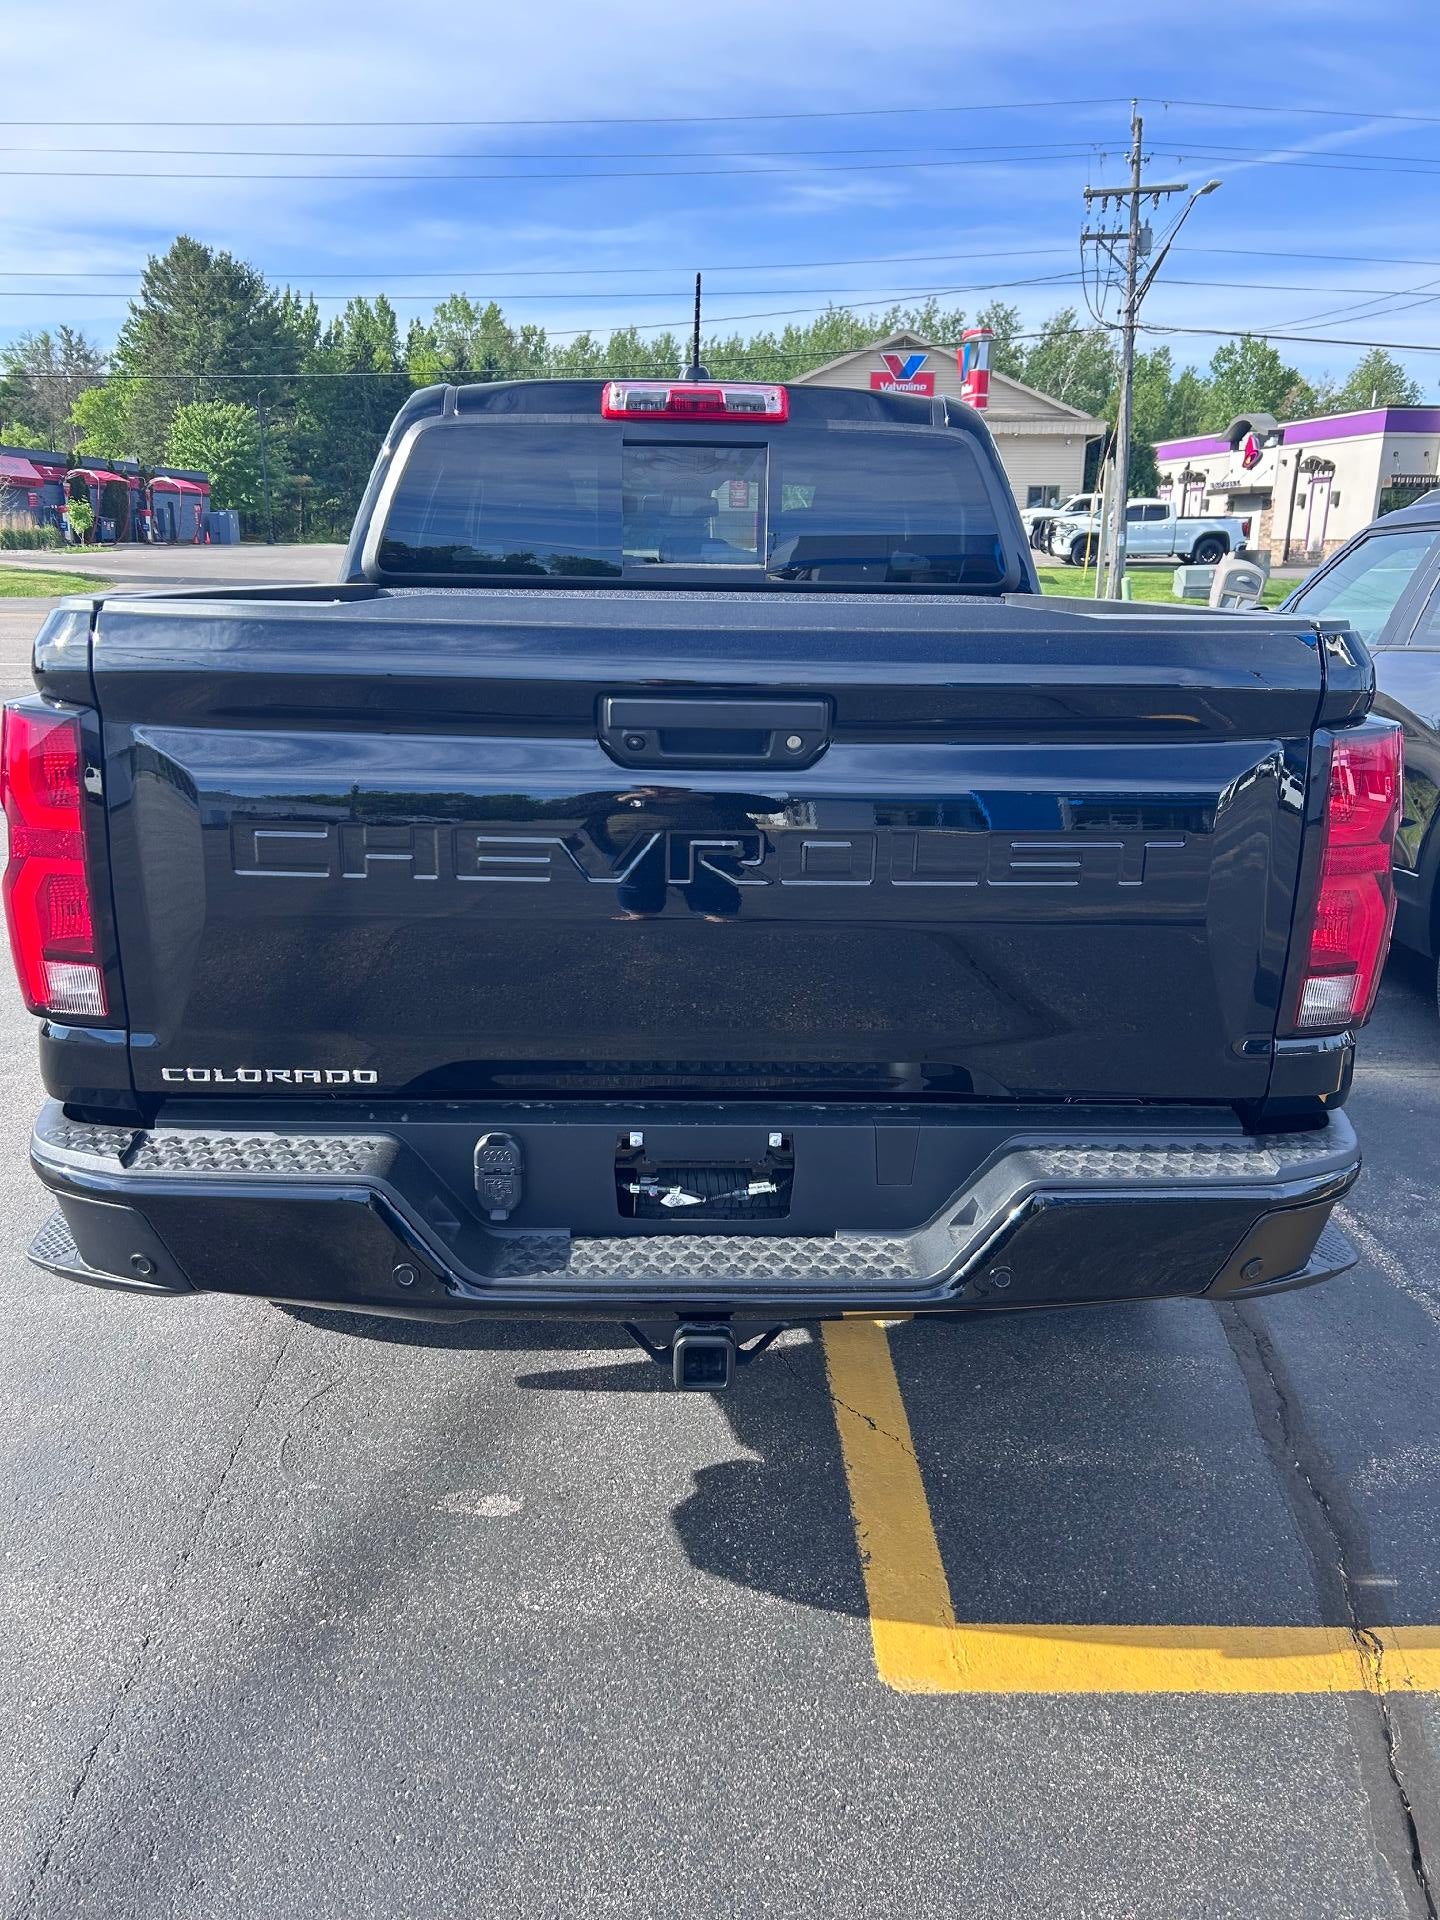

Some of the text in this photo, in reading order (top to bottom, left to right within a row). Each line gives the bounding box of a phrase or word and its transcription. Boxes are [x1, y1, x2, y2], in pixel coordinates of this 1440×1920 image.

[880, 382, 927, 391] Valvoline
[230, 818, 1187, 886] CHEVROLET
[161, 1067, 378, 1084] COLORADO
